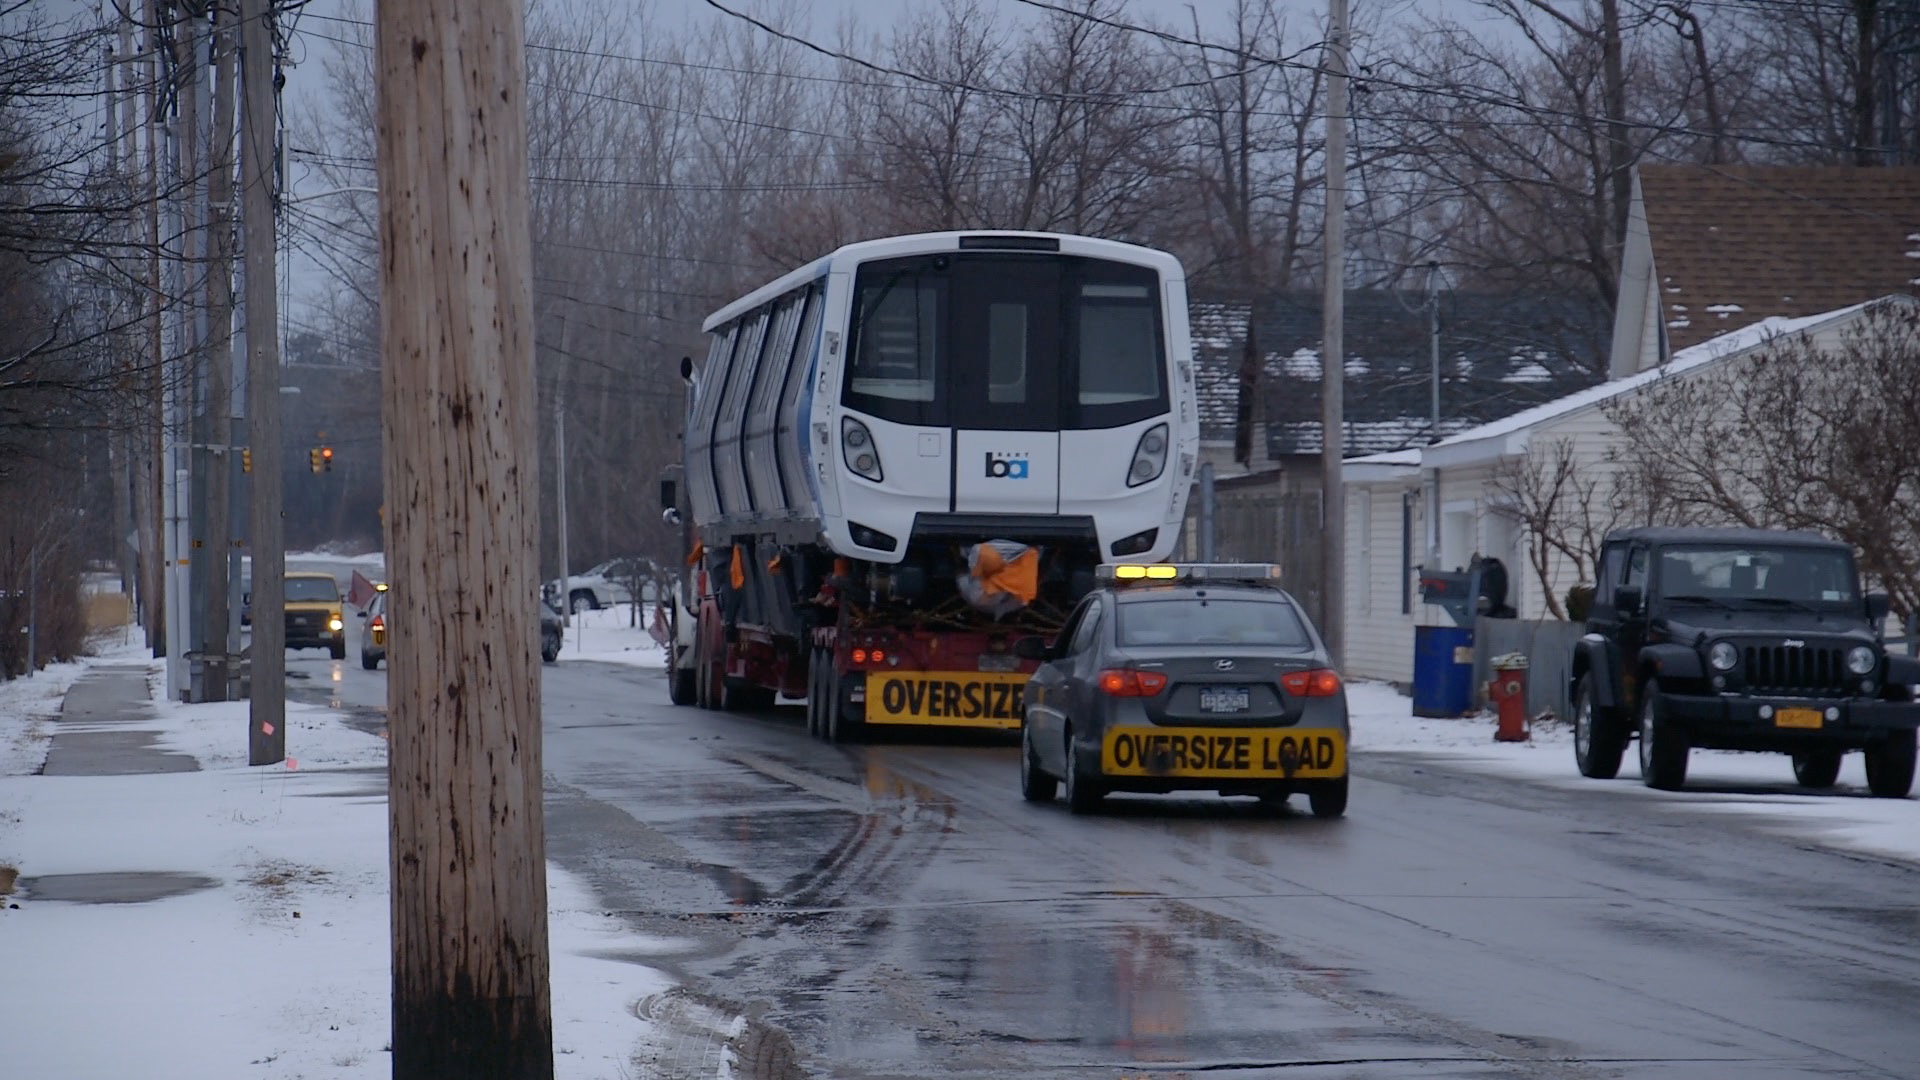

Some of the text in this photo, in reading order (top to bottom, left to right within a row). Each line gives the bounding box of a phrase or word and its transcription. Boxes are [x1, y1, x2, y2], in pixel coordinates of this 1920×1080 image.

[1784, 639, 1804, 648] Jeep
[883, 678, 1025, 718] OVERSIZE
[1114, 733, 1334, 770] OVERSIZE LOAD
